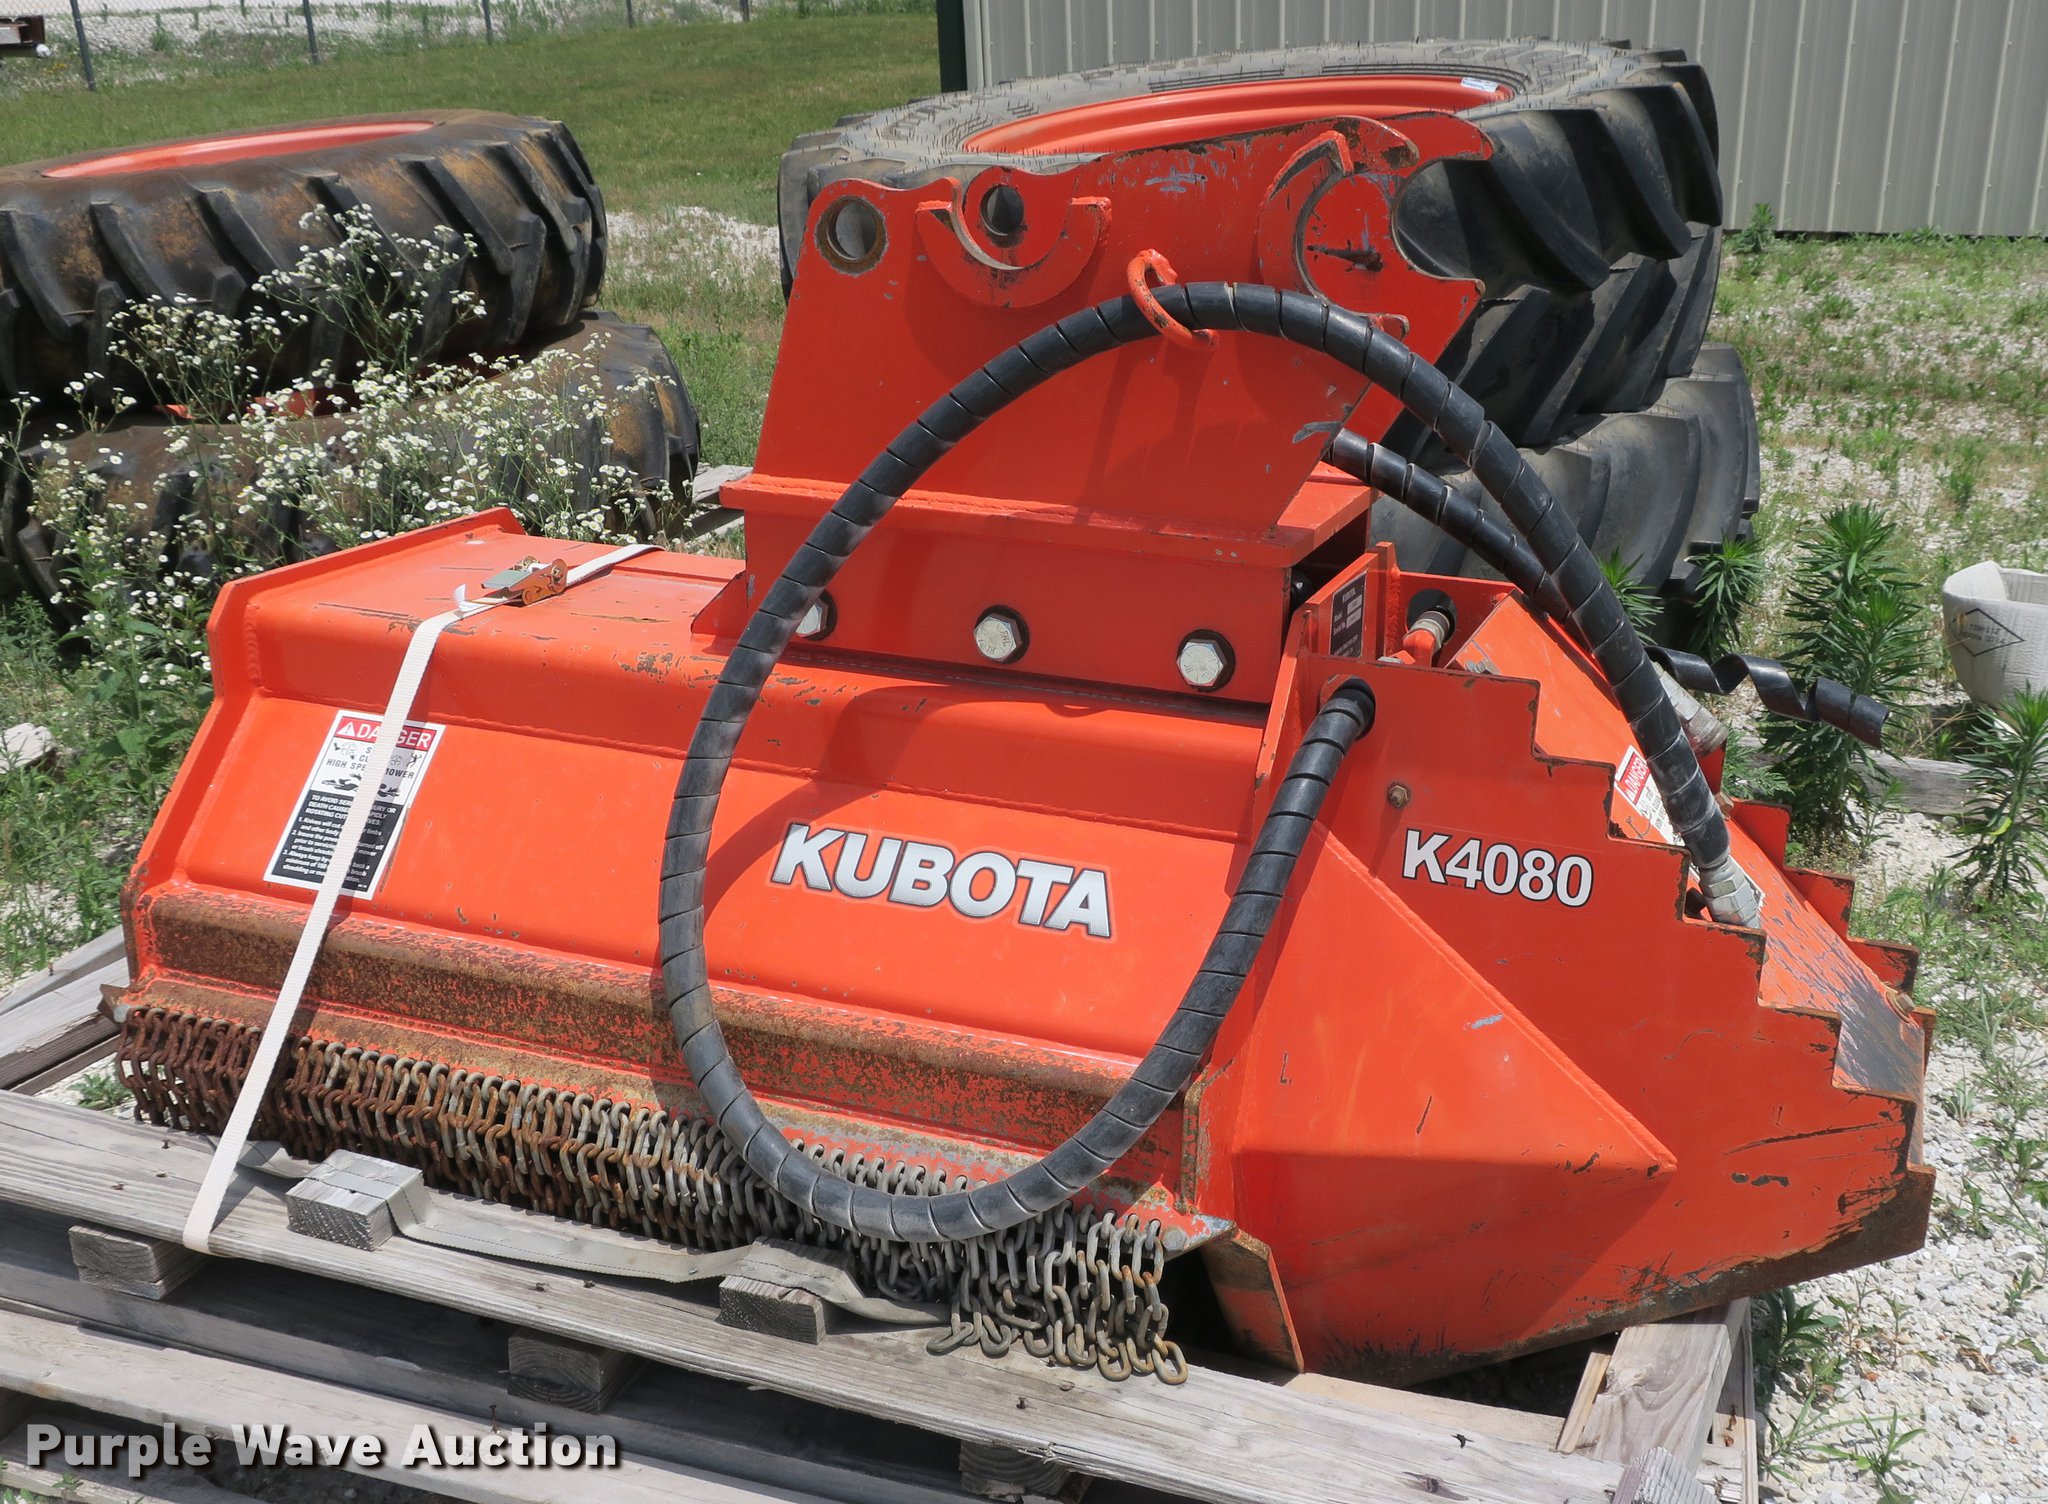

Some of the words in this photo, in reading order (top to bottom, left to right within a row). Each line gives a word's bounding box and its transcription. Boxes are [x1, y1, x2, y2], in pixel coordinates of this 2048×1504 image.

[356, 724, 432, 748] DAGER
[327, 759, 348, 768] HIGH
[350, 763, 367, 771] SPE
[1624, 756, 1649, 794] DANGER
[305, 808, 335, 817] ROTATING
[308, 801, 329, 809] DEATH
[288, 851, 307, 859] Always
[1402, 828, 1594, 907] K4080
[771, 822, 1111, 938] KUBOTA
